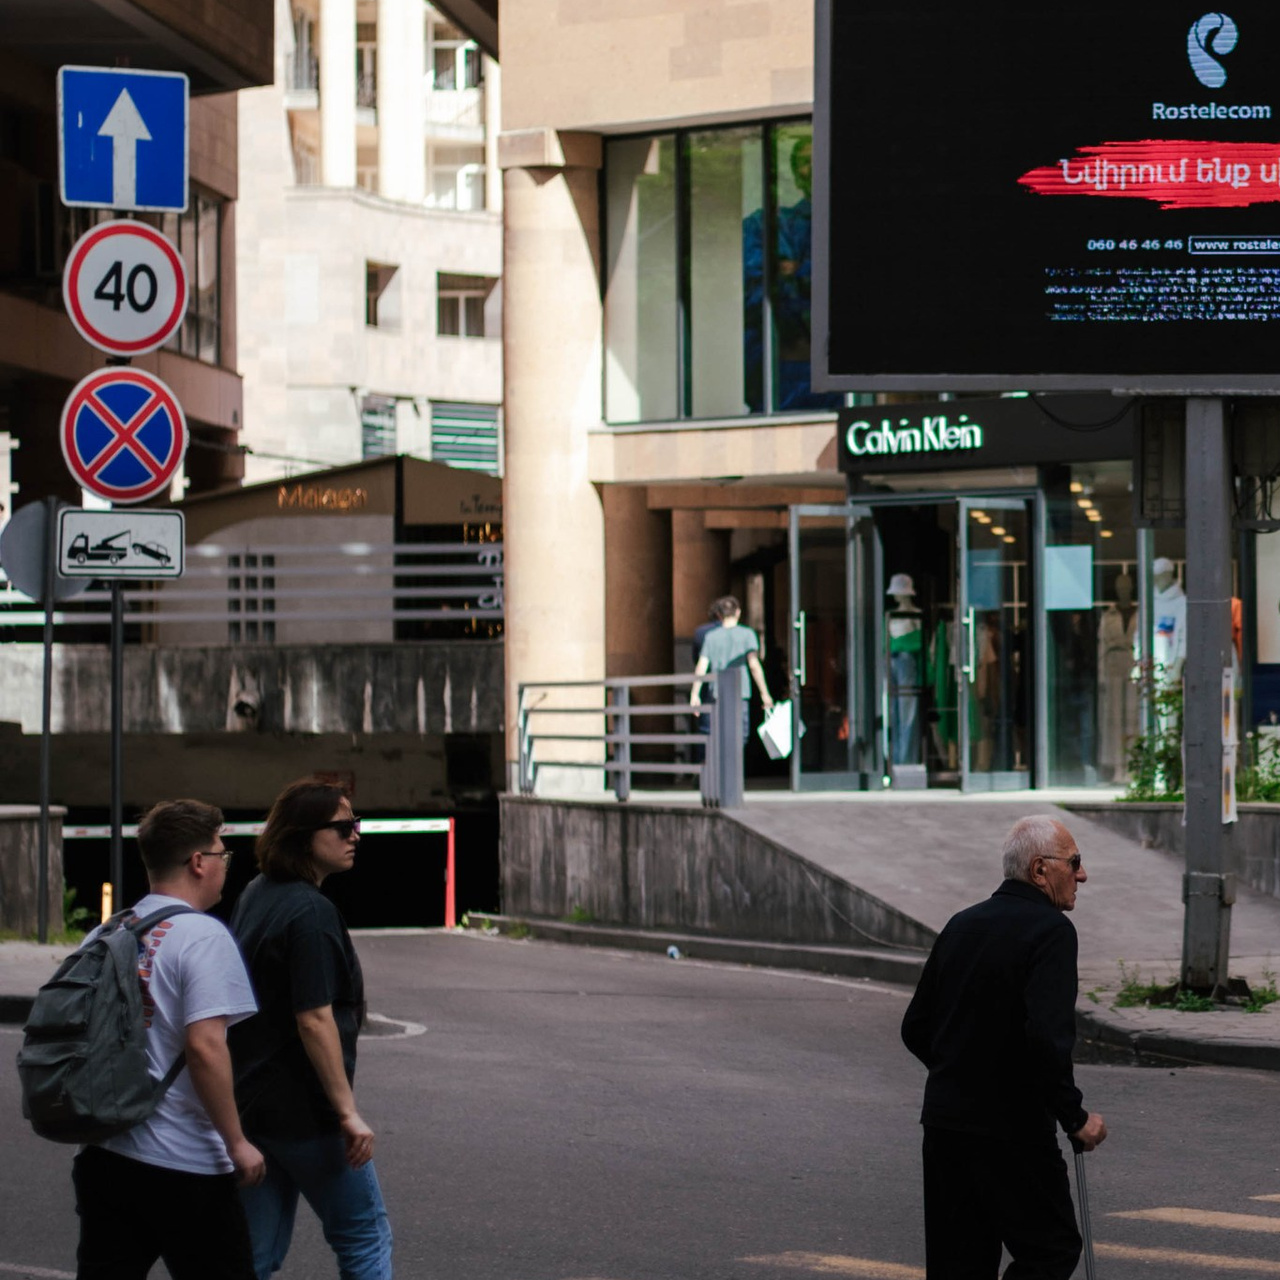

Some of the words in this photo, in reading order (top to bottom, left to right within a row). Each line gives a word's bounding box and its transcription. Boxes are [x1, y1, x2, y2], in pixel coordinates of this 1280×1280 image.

[1152, 102, 1271, 119] Rostelecom
[1060, 158, 1189, 190] Նվիրում
[1197, 157, 1250, 189] ենք
[1087, 239, 1115, 250] 060
[1119, 239, 1138, 250] 46
[1141, 239, 1160, 250] 46
[1164, 239, 1183, 250] 46
[94, 260, 158, 313] 40
[847, 418, 921, 455] Calvin
[922, 415, 982, 451] Klein
